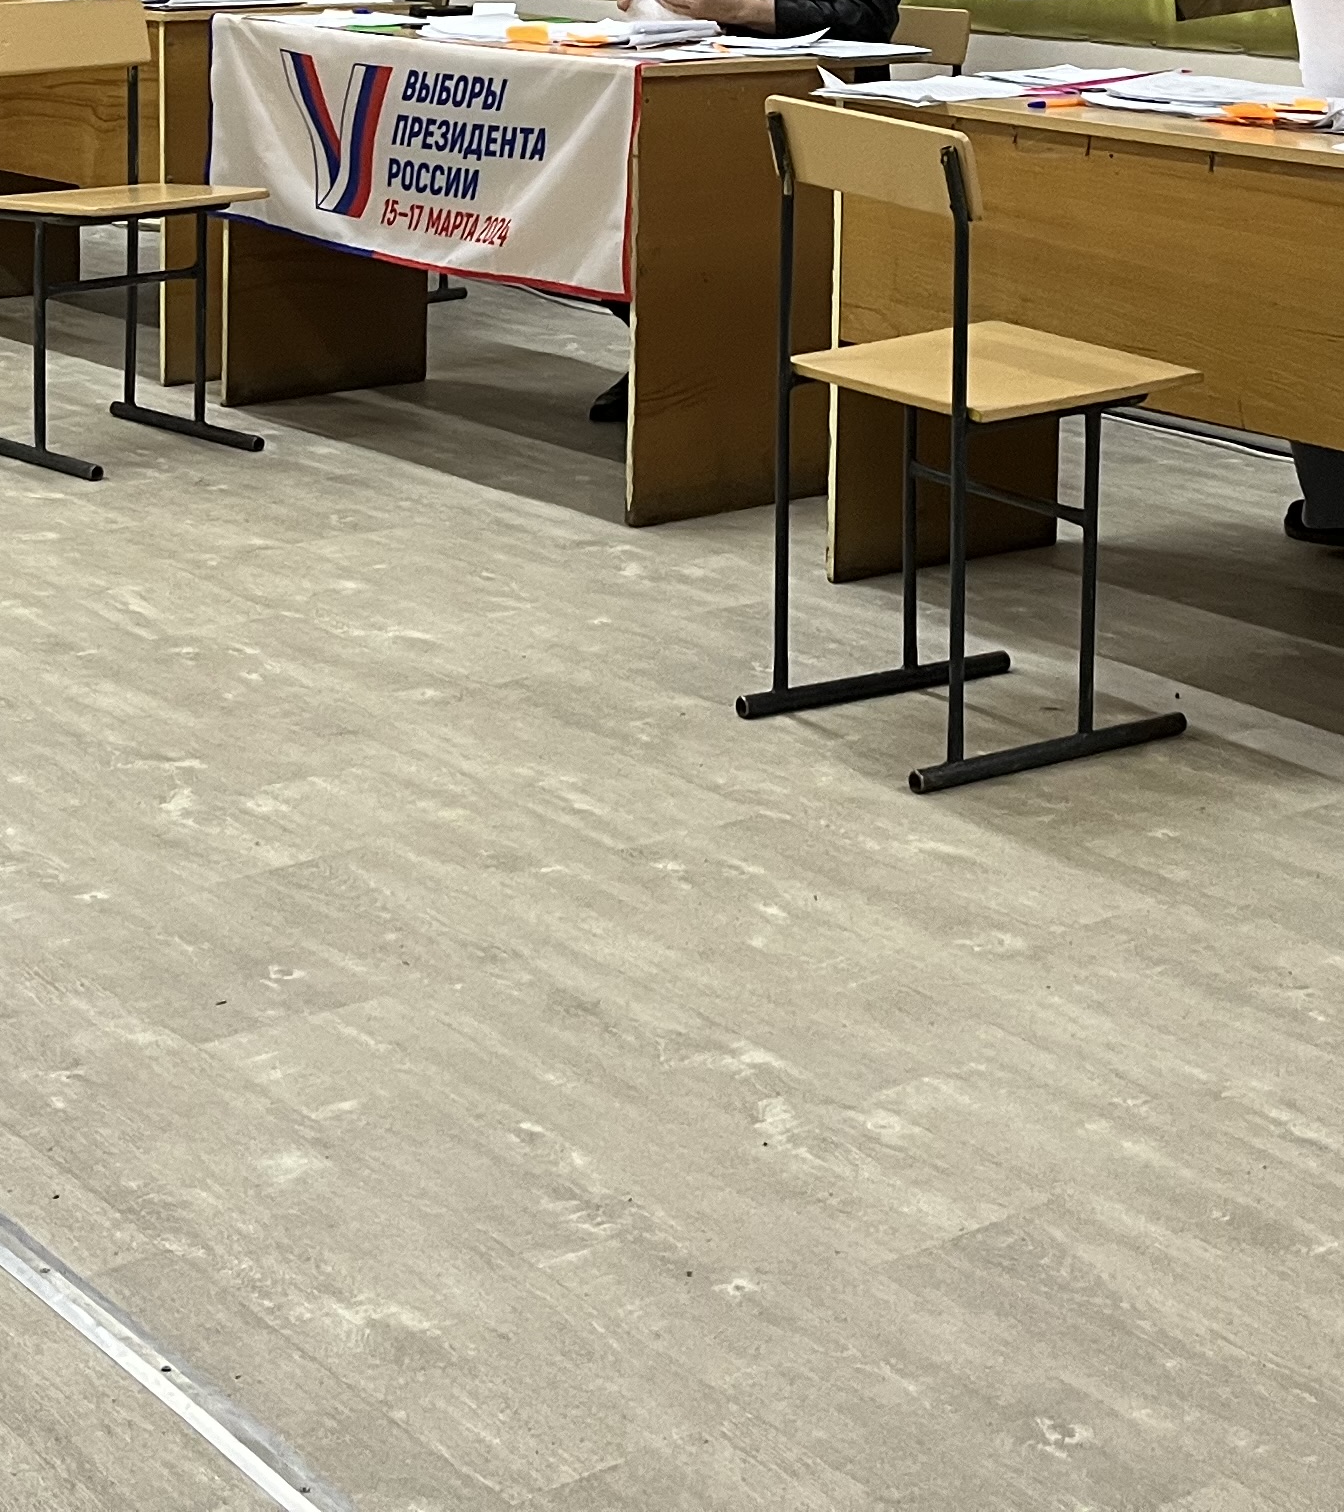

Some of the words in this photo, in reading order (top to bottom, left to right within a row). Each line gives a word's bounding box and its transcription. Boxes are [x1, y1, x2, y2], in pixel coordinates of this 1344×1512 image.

[401, 69, 509, 112] ВЫБОРЫ
[391, 114, 546, 162] ПРЕЗИДЕНТА
[387, 157, 480, 201] РОССИИ
[424, 206, 481, 243] МАРТА
[474, 215, 512, 248] 2024
